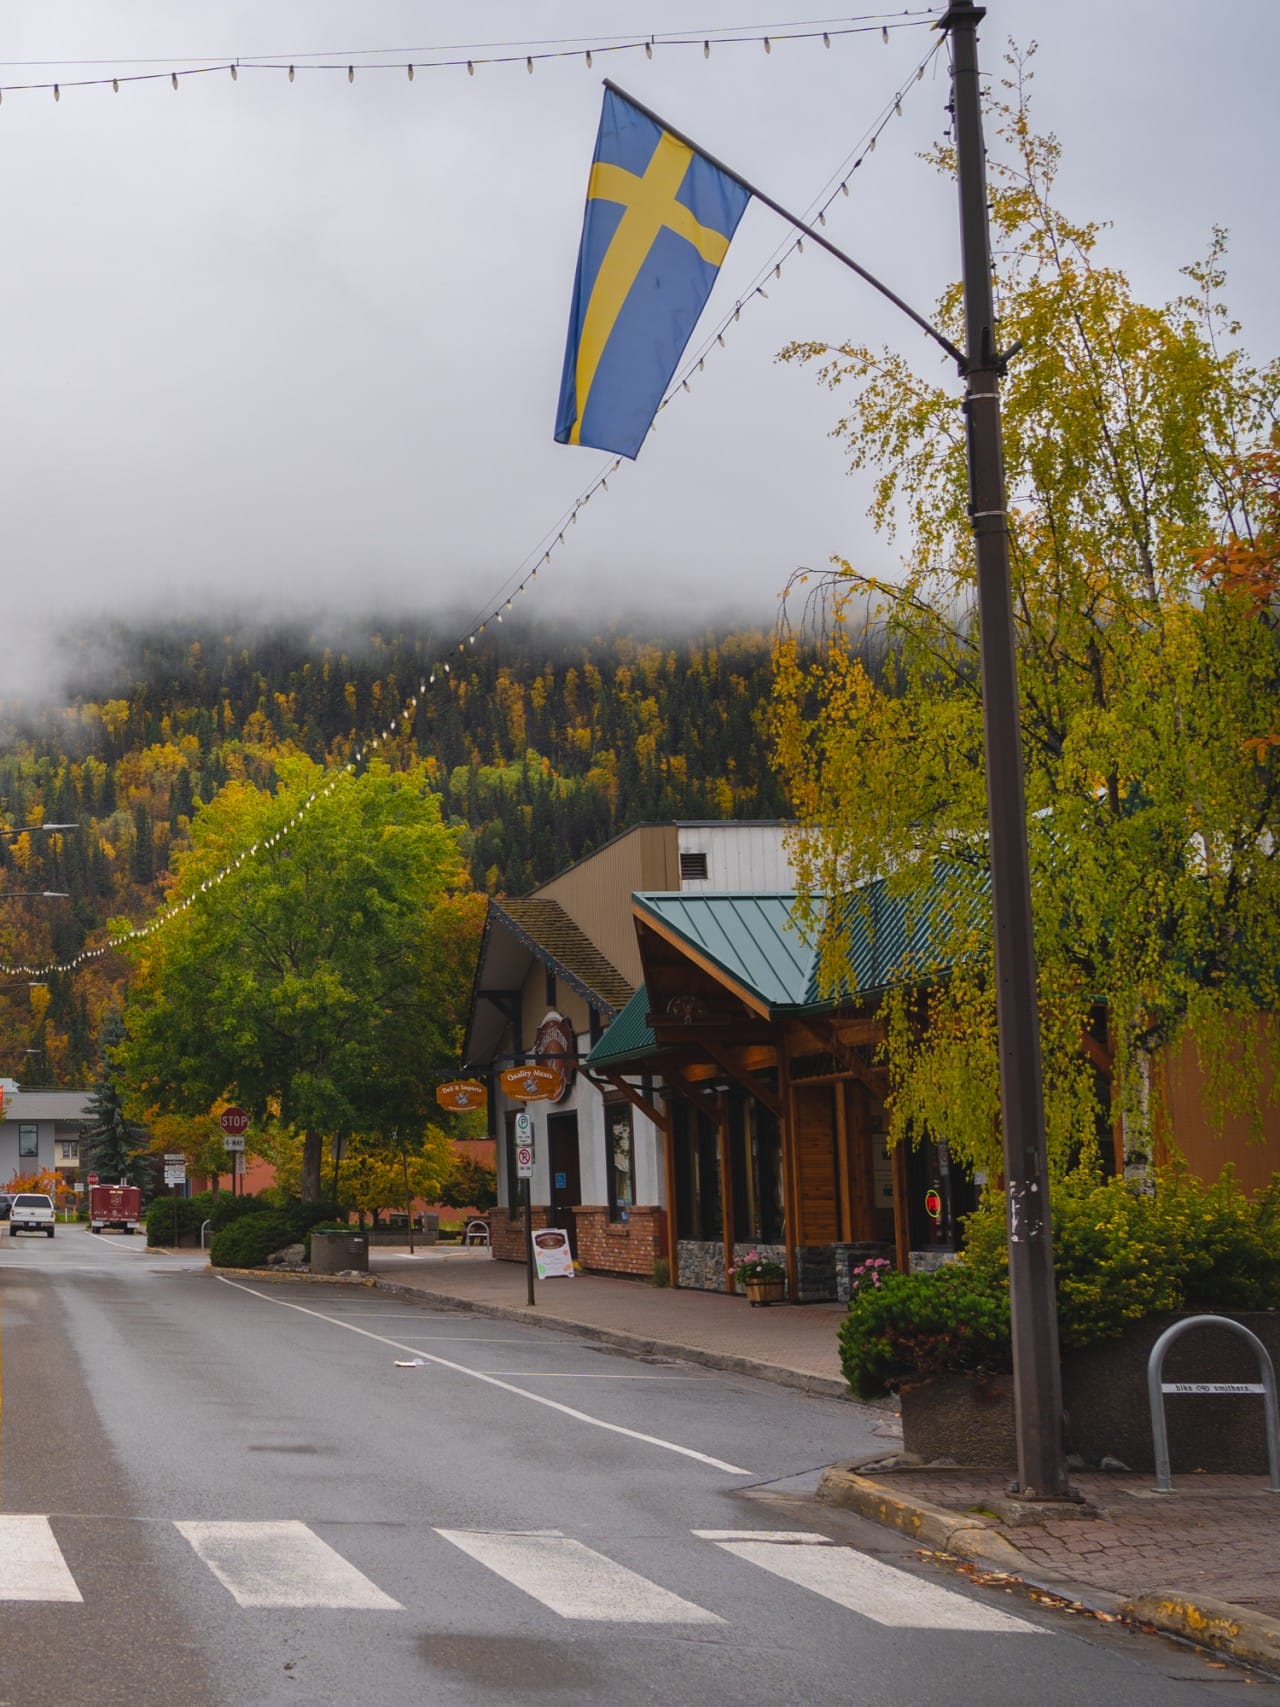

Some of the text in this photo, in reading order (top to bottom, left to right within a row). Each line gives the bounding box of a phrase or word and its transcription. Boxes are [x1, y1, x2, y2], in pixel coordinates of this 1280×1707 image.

[507, 1069, 553, 1081] Quality Meats
[222, 1115, 248, 1127] STOP
[1175, 1384, 1249, 1393] bike smithers
